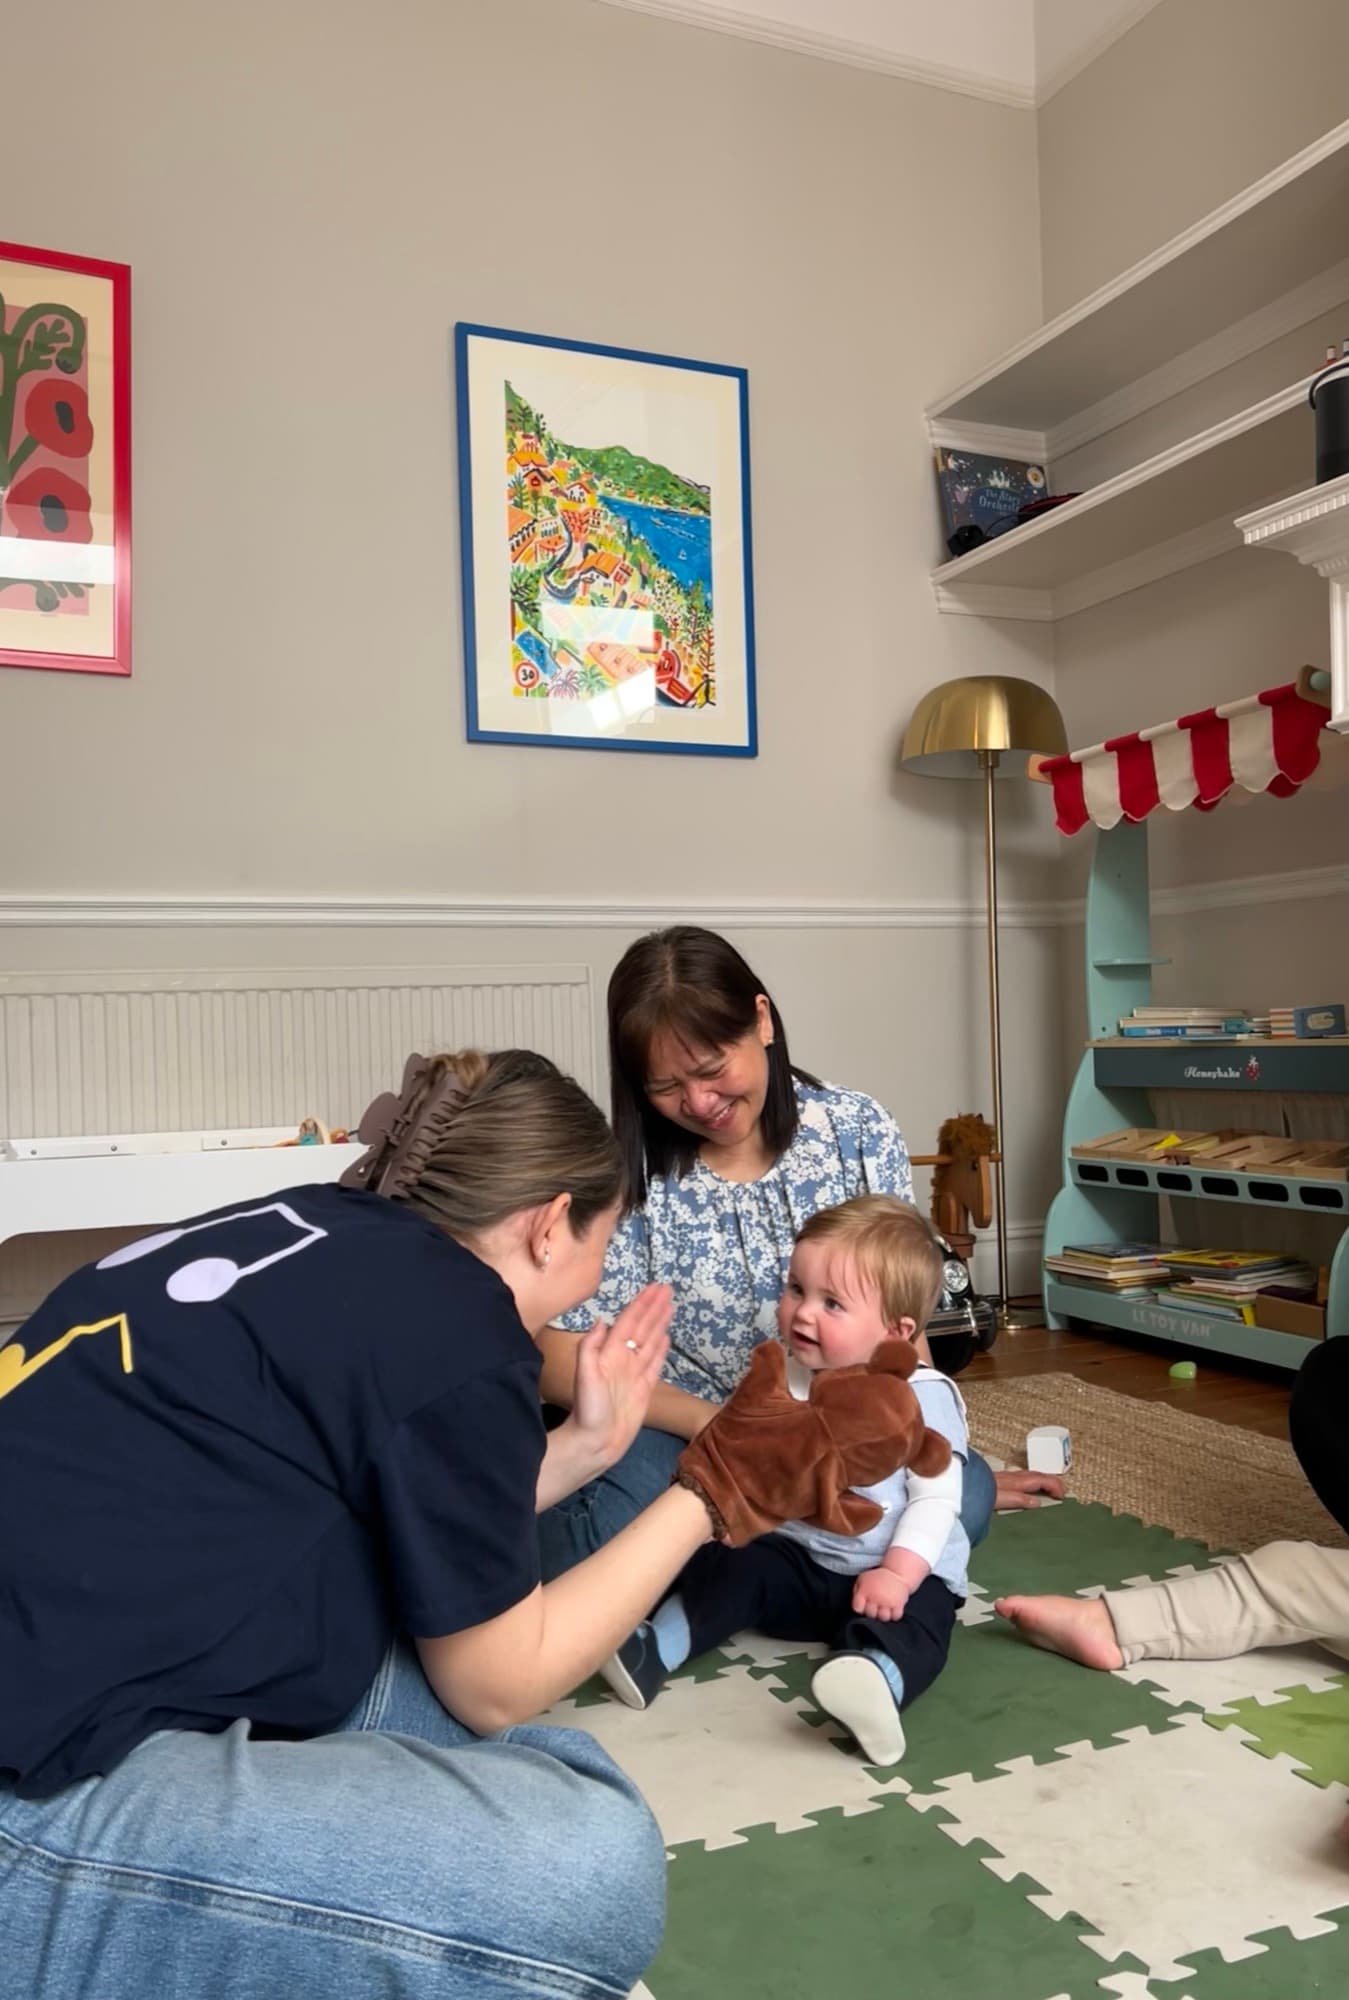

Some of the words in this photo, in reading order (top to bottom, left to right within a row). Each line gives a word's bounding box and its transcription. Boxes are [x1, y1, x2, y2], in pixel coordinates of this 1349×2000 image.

[521, 668, 535, 681] 30
[1132, 1309, 1146, 1323] LE
[1149, 1311, 1177, 1332] TOY
[1181, 1319, 1210, 1337] VAN
